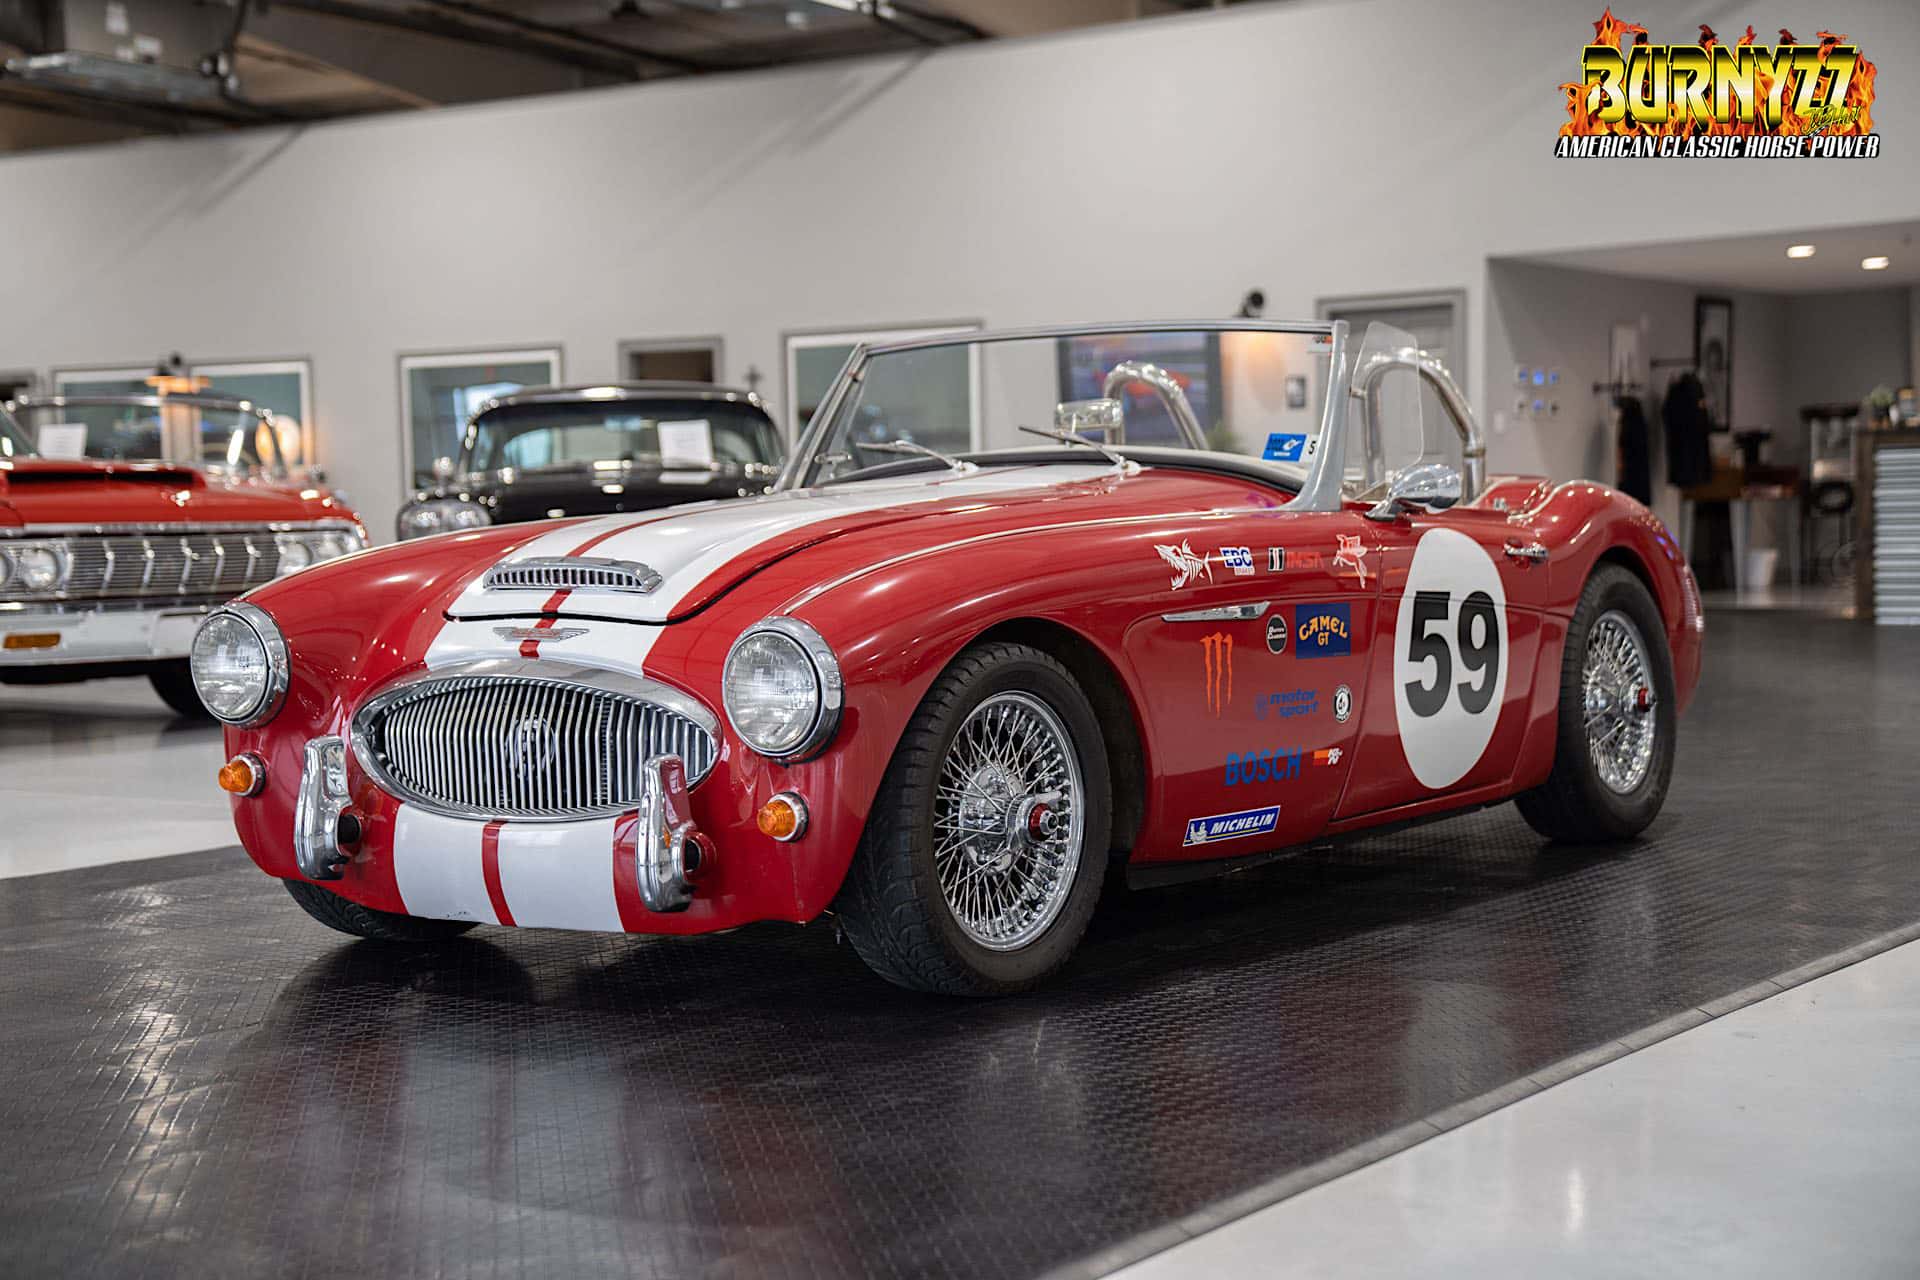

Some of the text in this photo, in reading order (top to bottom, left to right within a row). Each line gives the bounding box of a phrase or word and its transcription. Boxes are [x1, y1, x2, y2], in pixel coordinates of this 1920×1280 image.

[1222, 549, 1252, 567] EBC
[1298, 615, 1348, 641] CAMEL
[1317, 631, 1330, 646] GT
[1404, 590, 1500, 718] 59
[1225, 744, 1302, 786] BOSCH
[1209, 813, 1276, 835] MICHELIN
